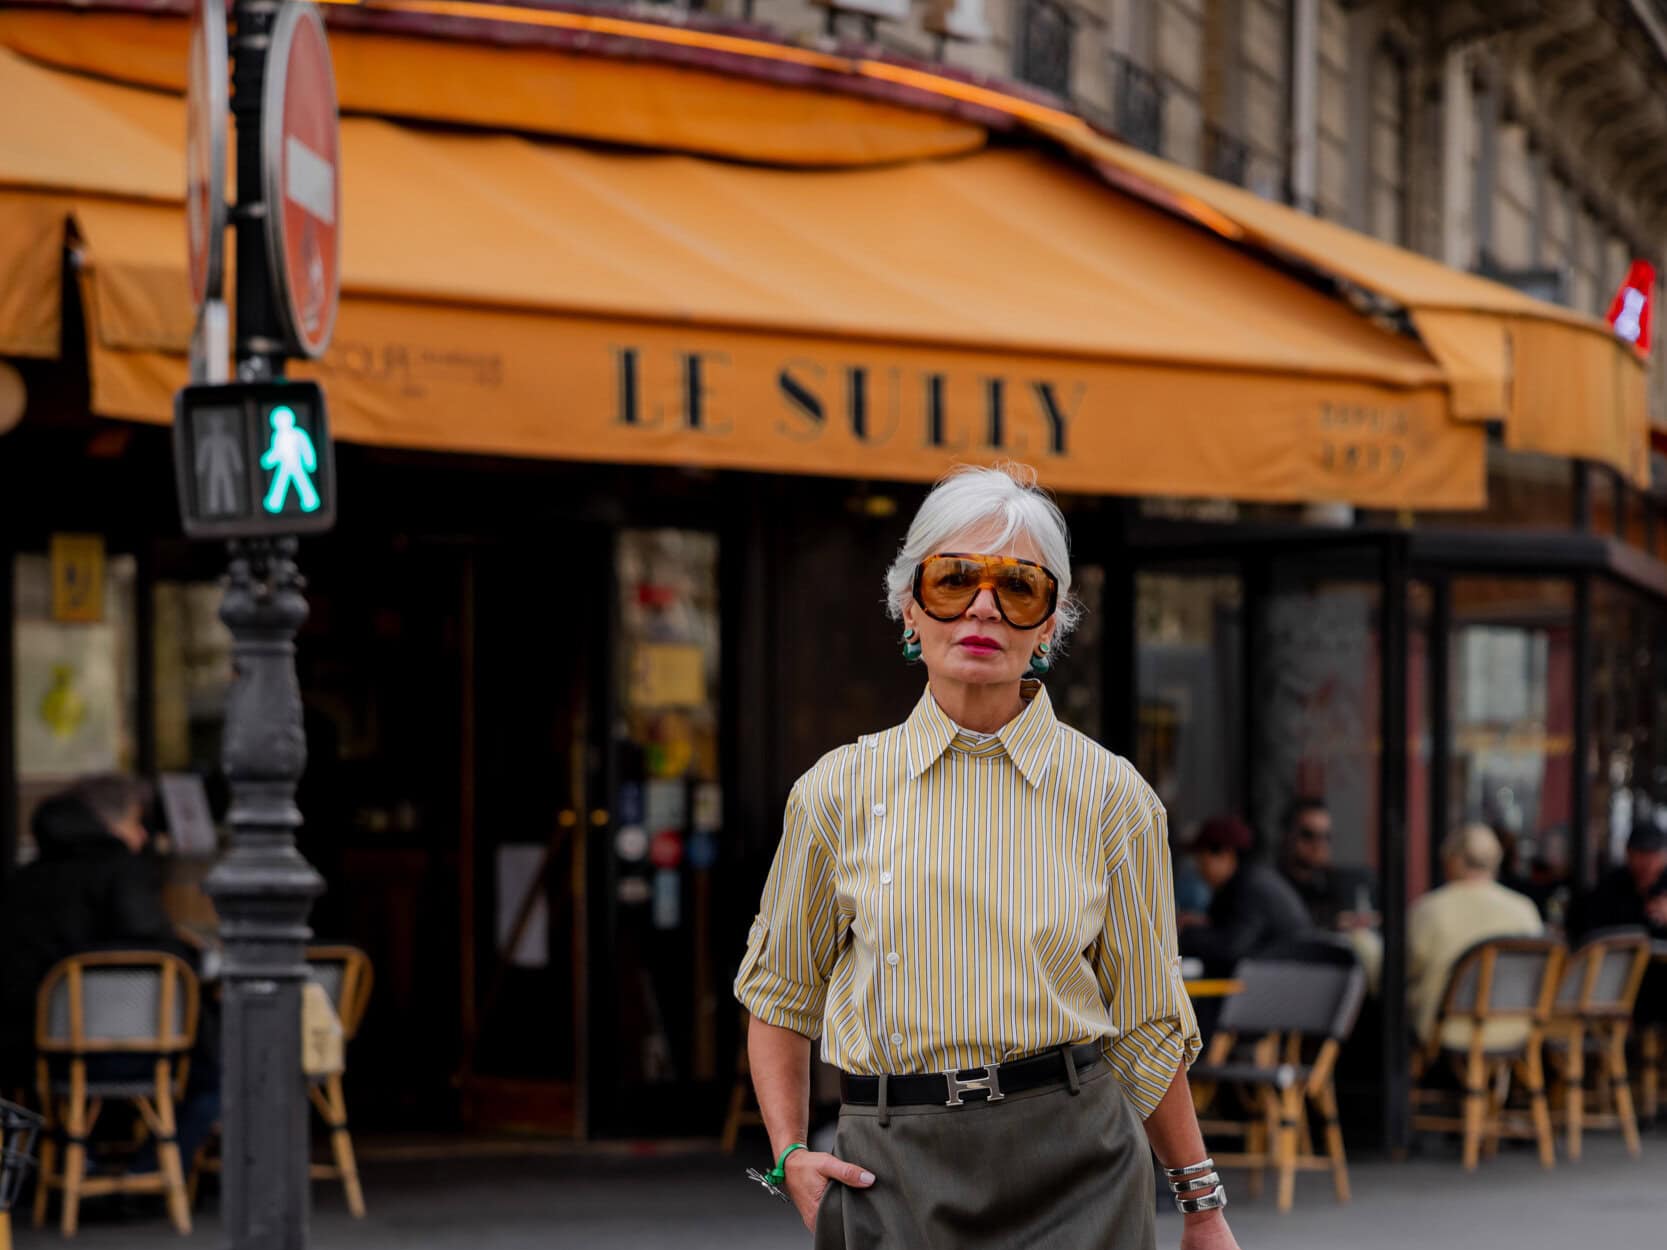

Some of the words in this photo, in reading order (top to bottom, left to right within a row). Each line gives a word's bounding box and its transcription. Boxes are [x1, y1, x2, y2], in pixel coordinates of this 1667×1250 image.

[609, 345, 733, 436] LE
[773, 357, 1087, 457] SULLY
[943, 1063, 1005, 1107] H
